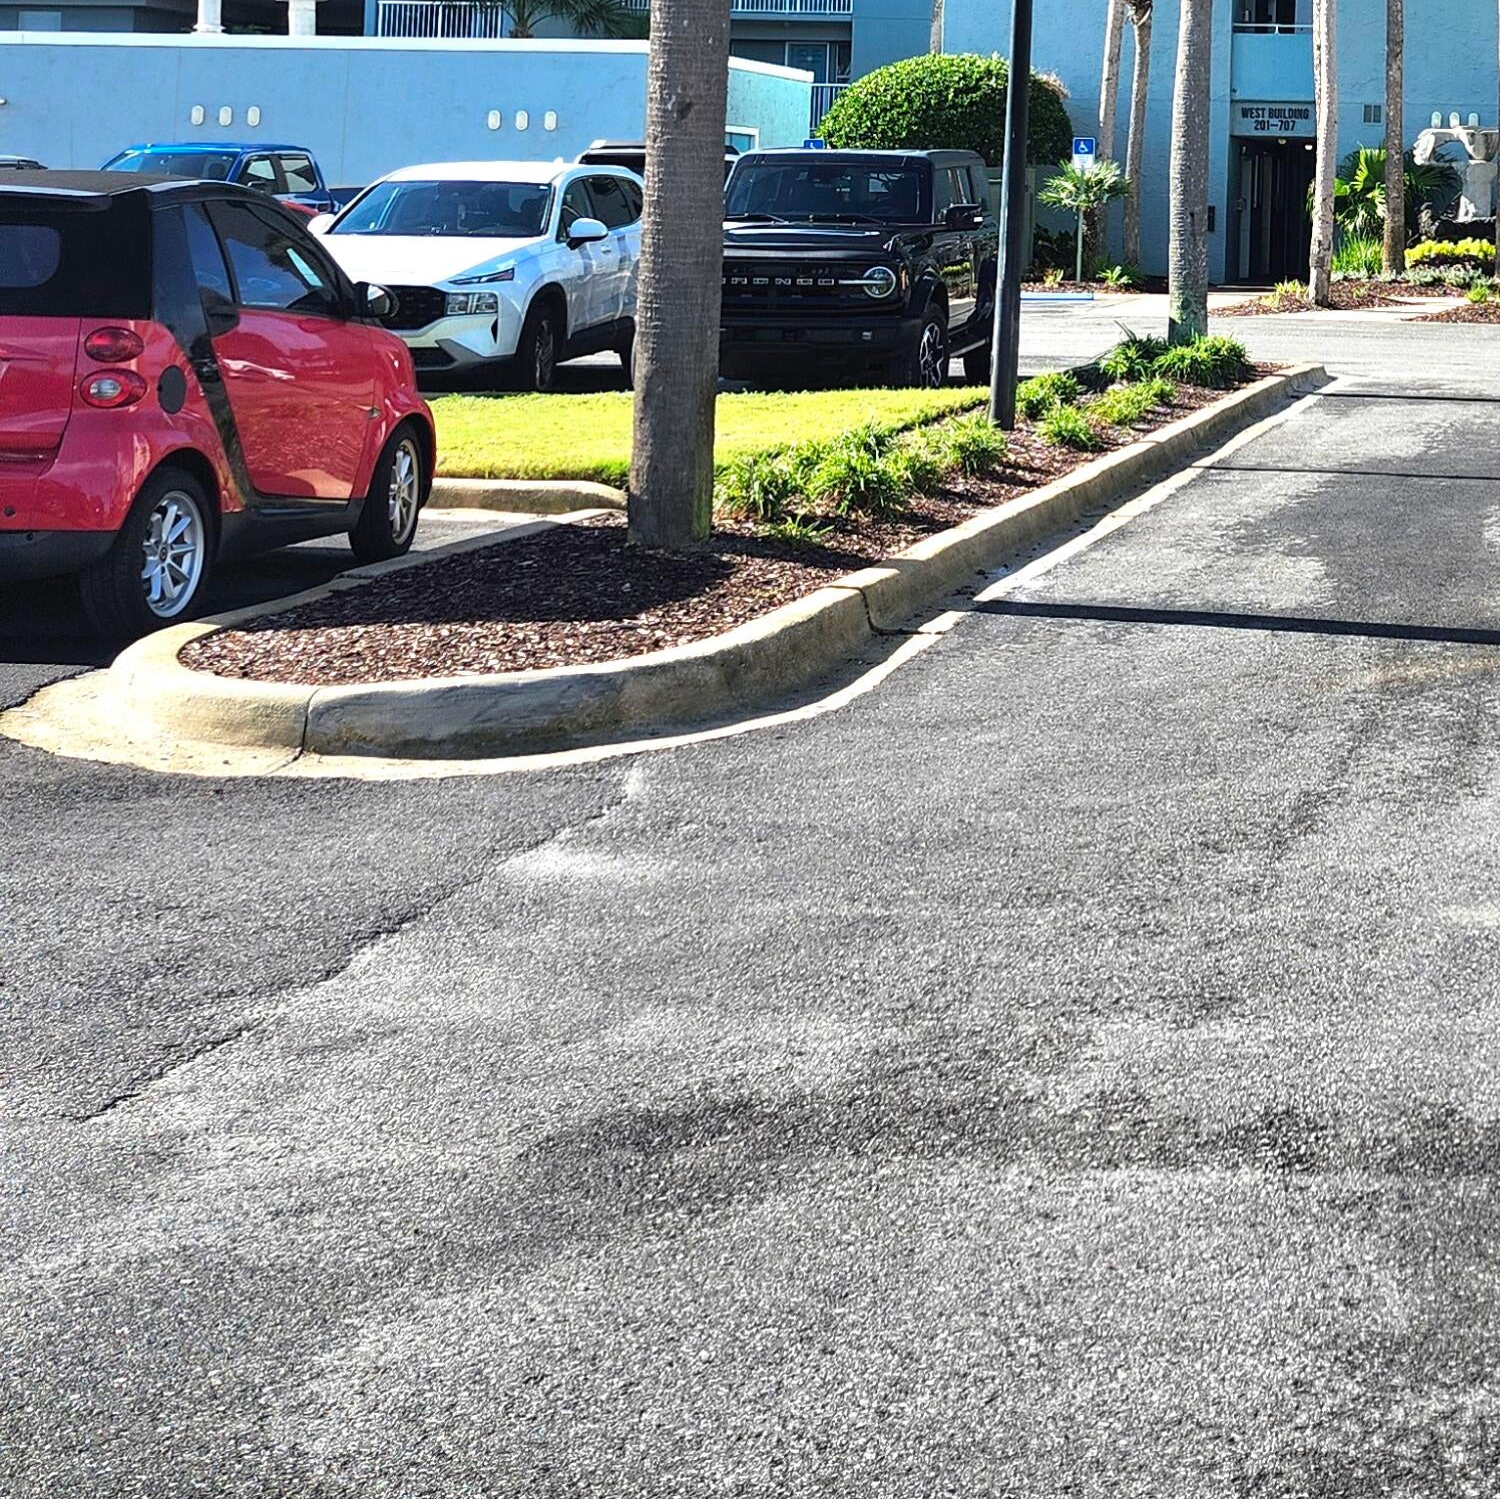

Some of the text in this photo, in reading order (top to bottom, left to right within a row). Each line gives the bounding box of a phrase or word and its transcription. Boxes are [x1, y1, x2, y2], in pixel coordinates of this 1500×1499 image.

[1241, 107, 1310, 120] WEST BUILDING
[1254, 120, 1296, 131] 201-707
[721, 277, 834, 286] RONCO
